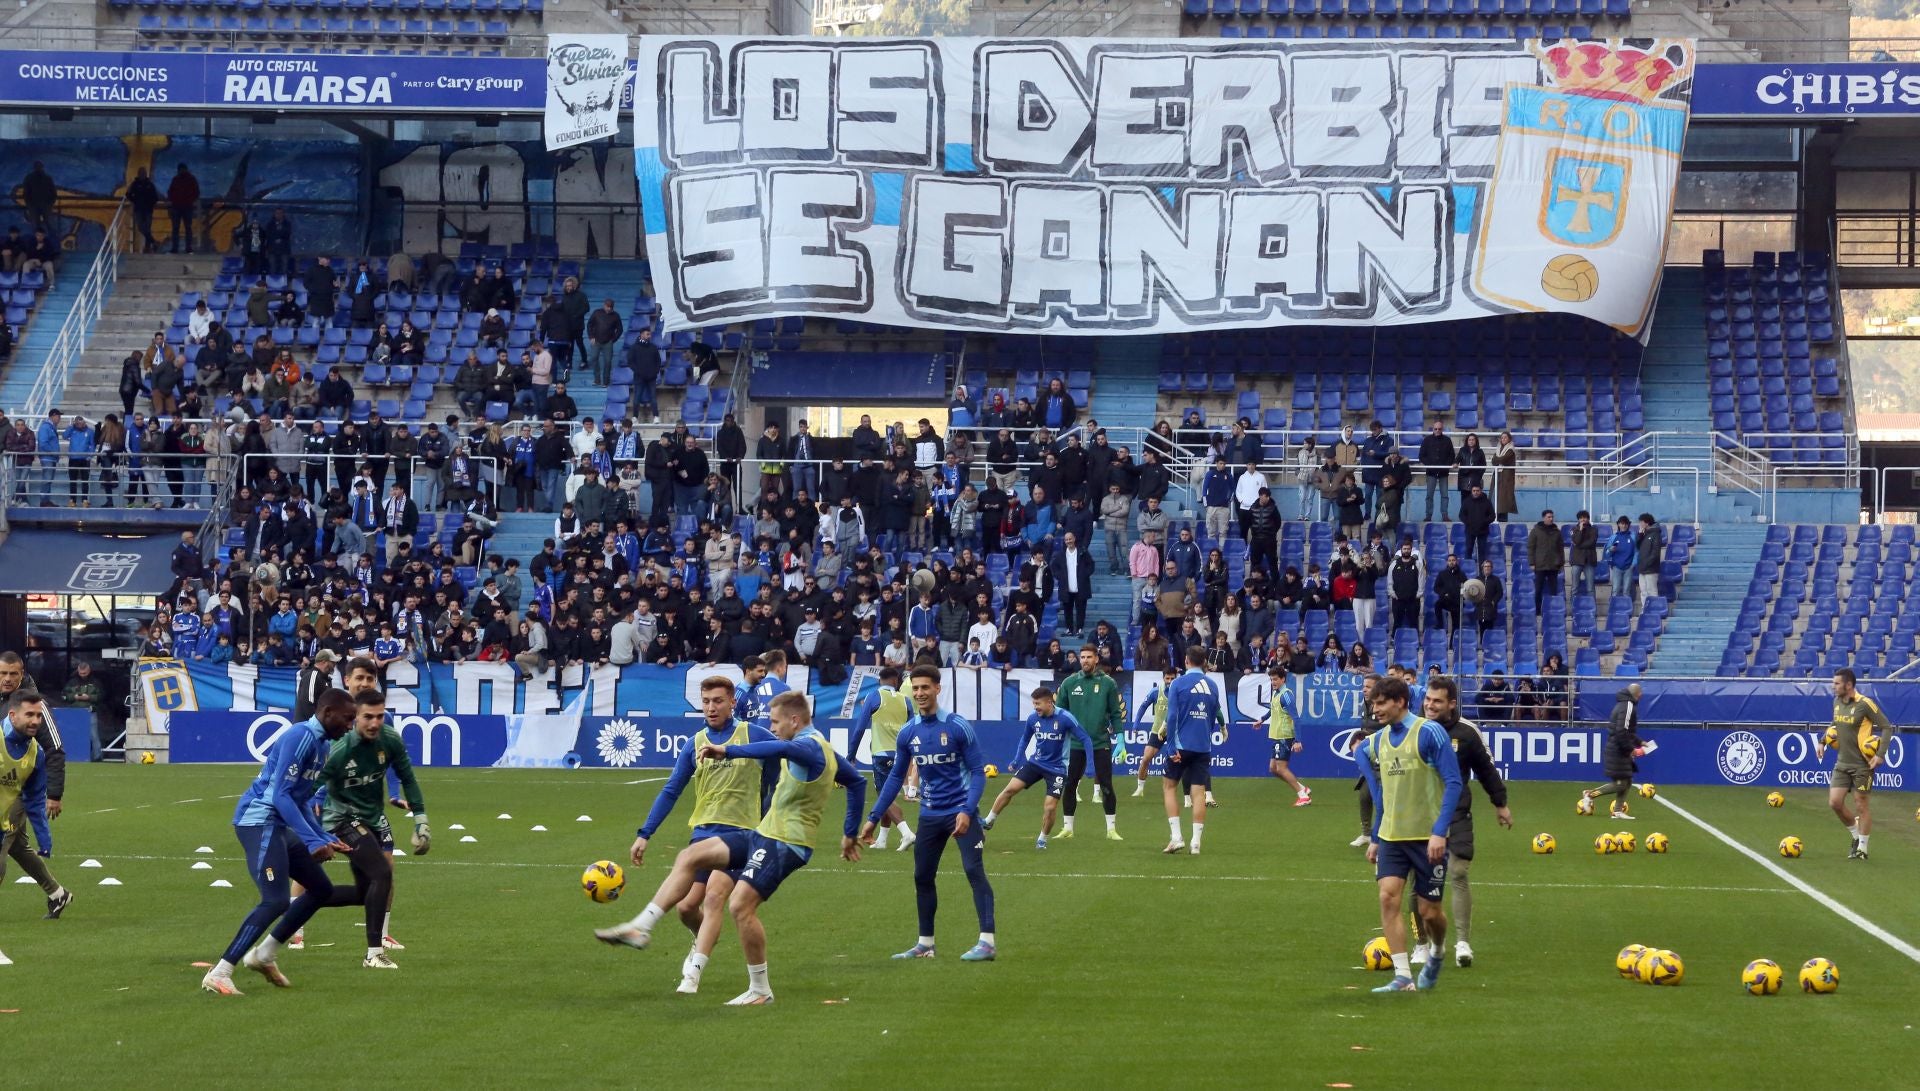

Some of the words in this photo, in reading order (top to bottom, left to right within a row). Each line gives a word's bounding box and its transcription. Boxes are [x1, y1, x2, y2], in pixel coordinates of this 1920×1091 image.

[19, 64, 168, 82] CONSTRUCCIONES
[227, 60, 264, 72] AUTO
[266, 60, 319, 72] CRISTAL
[76, 83, 168, 102] METÁLICAS
[223, 75, 393, 103] RALARSA
[403, 81, 422, 89] PART
[437, 76, 474, 91] Cary
[476, 77, 524, 92] group
[660, 41, 942, 169] LOS
[977, 42, 1538, 182] DERBIS
[1538, 99, 1581, 131] R.
[556, 130, 582, 143] FONDO
[583, 124, 609, 137] NORTE
[668, 168, 874, 321] SE
[898, 176, 1448, 331] GANAN
[1034, 732, 1062, 741] DIGI
[1724, 733, 1760, 750] OVIEDO
[1482, 731, 1602, 764] NDAI
[1777, 732, 1904, 769] OVO
[912, 752, 956, 765] DIGI
[1778, 770, 1832, 785] ORIGEN
[1872, 772, 1904, 788] MINO
